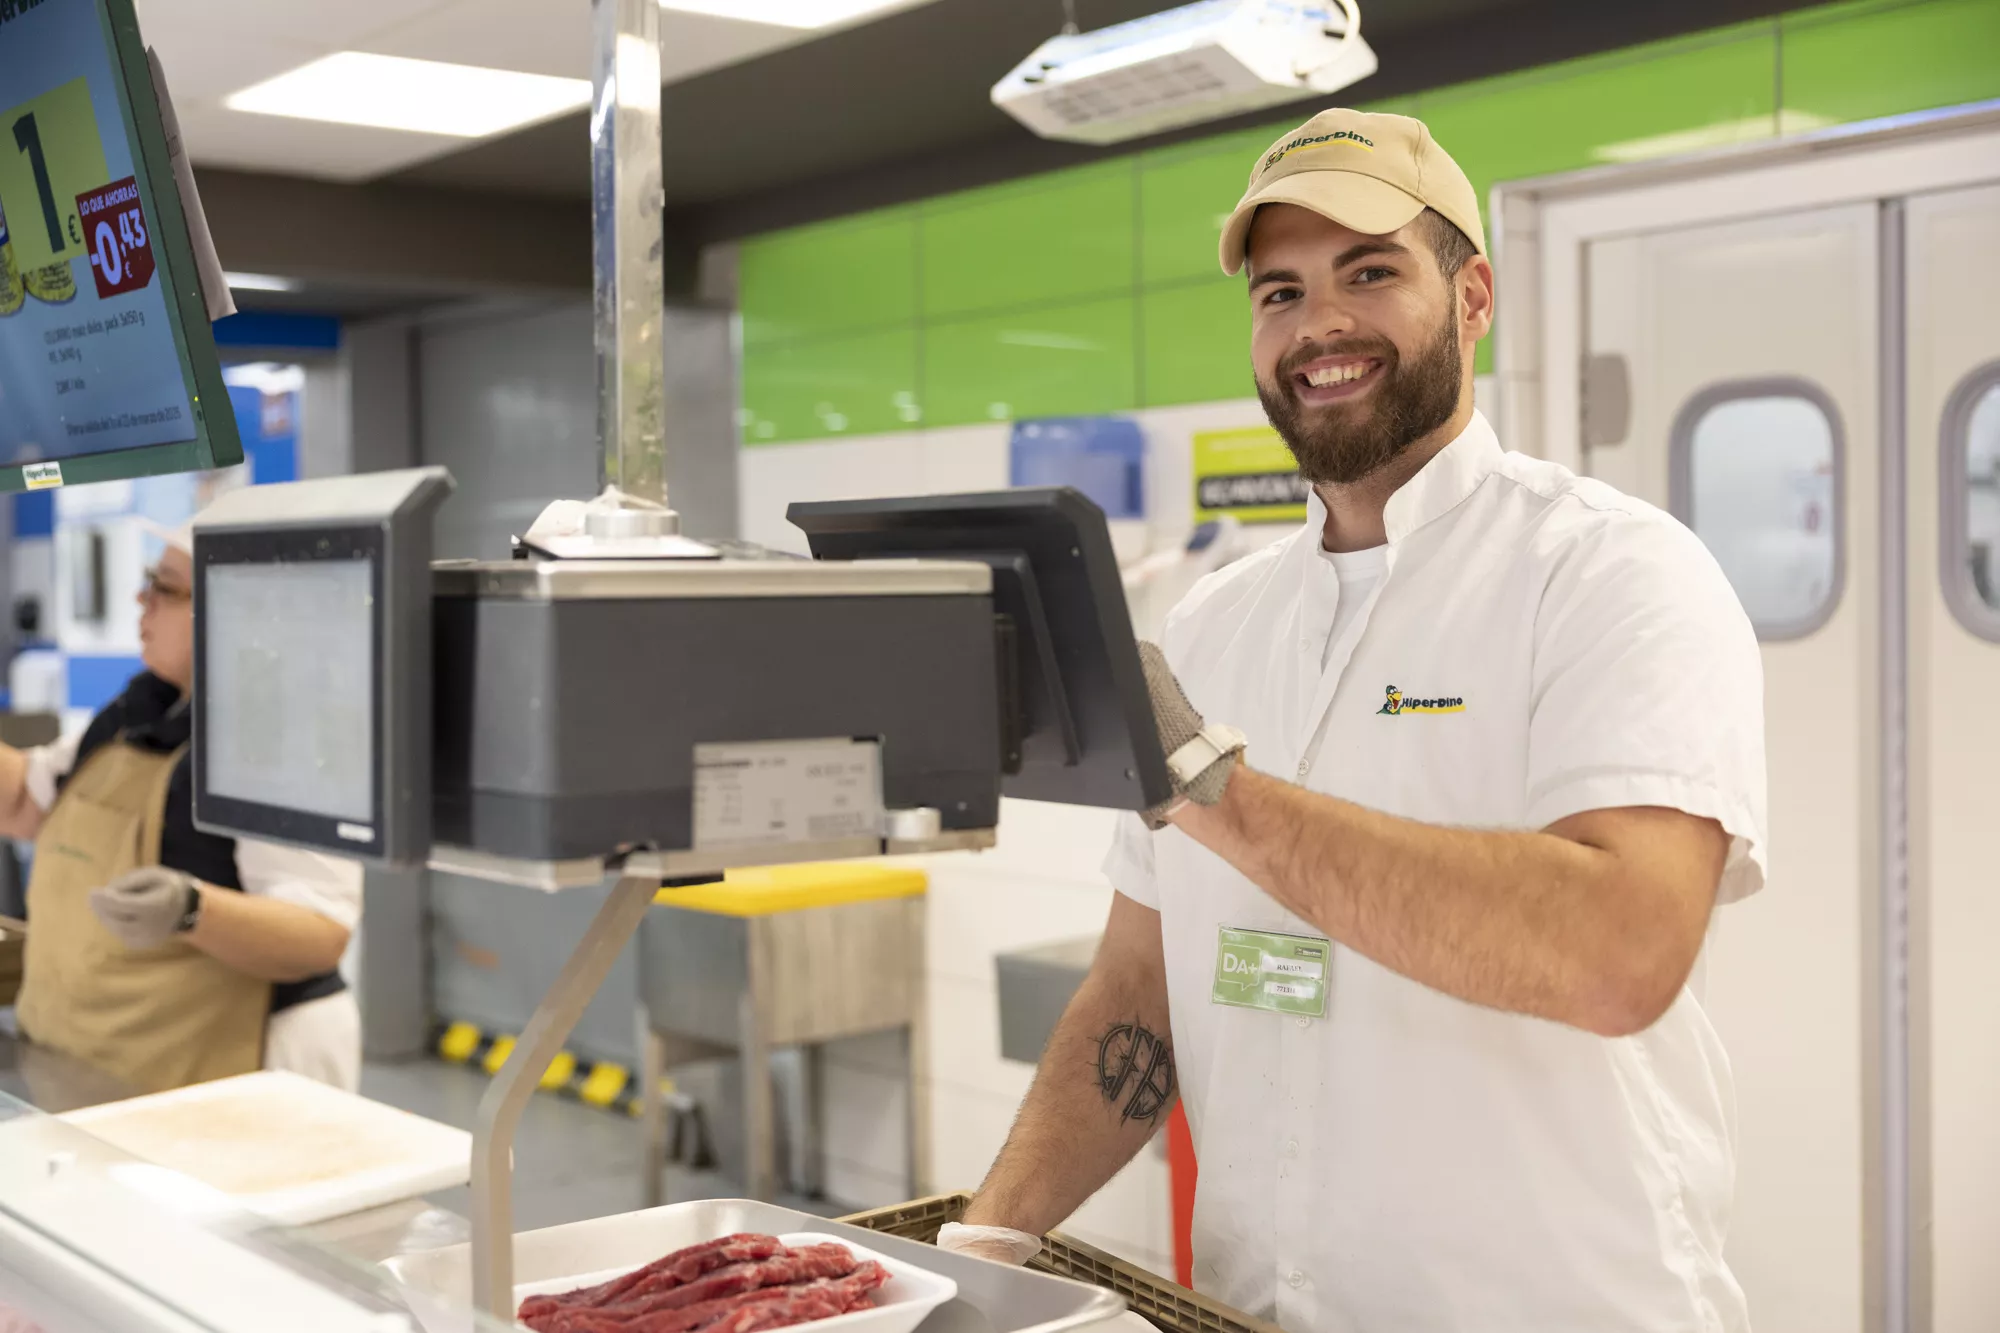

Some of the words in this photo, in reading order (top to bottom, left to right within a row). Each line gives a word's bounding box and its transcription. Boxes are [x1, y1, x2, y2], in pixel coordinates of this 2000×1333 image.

[1286, 131, 1374, 151] HiperDino
[12, 111, 65, 254] 1
[68, 214, 81, 244] €
[80, 201, 89, 216] LO
[89, 195, 104, 213] QUE
[105, 184, 138, 208] AHORRAS
[139, 311, 145, 327] g
[1401, 697, 1463, 709] HiperDino
